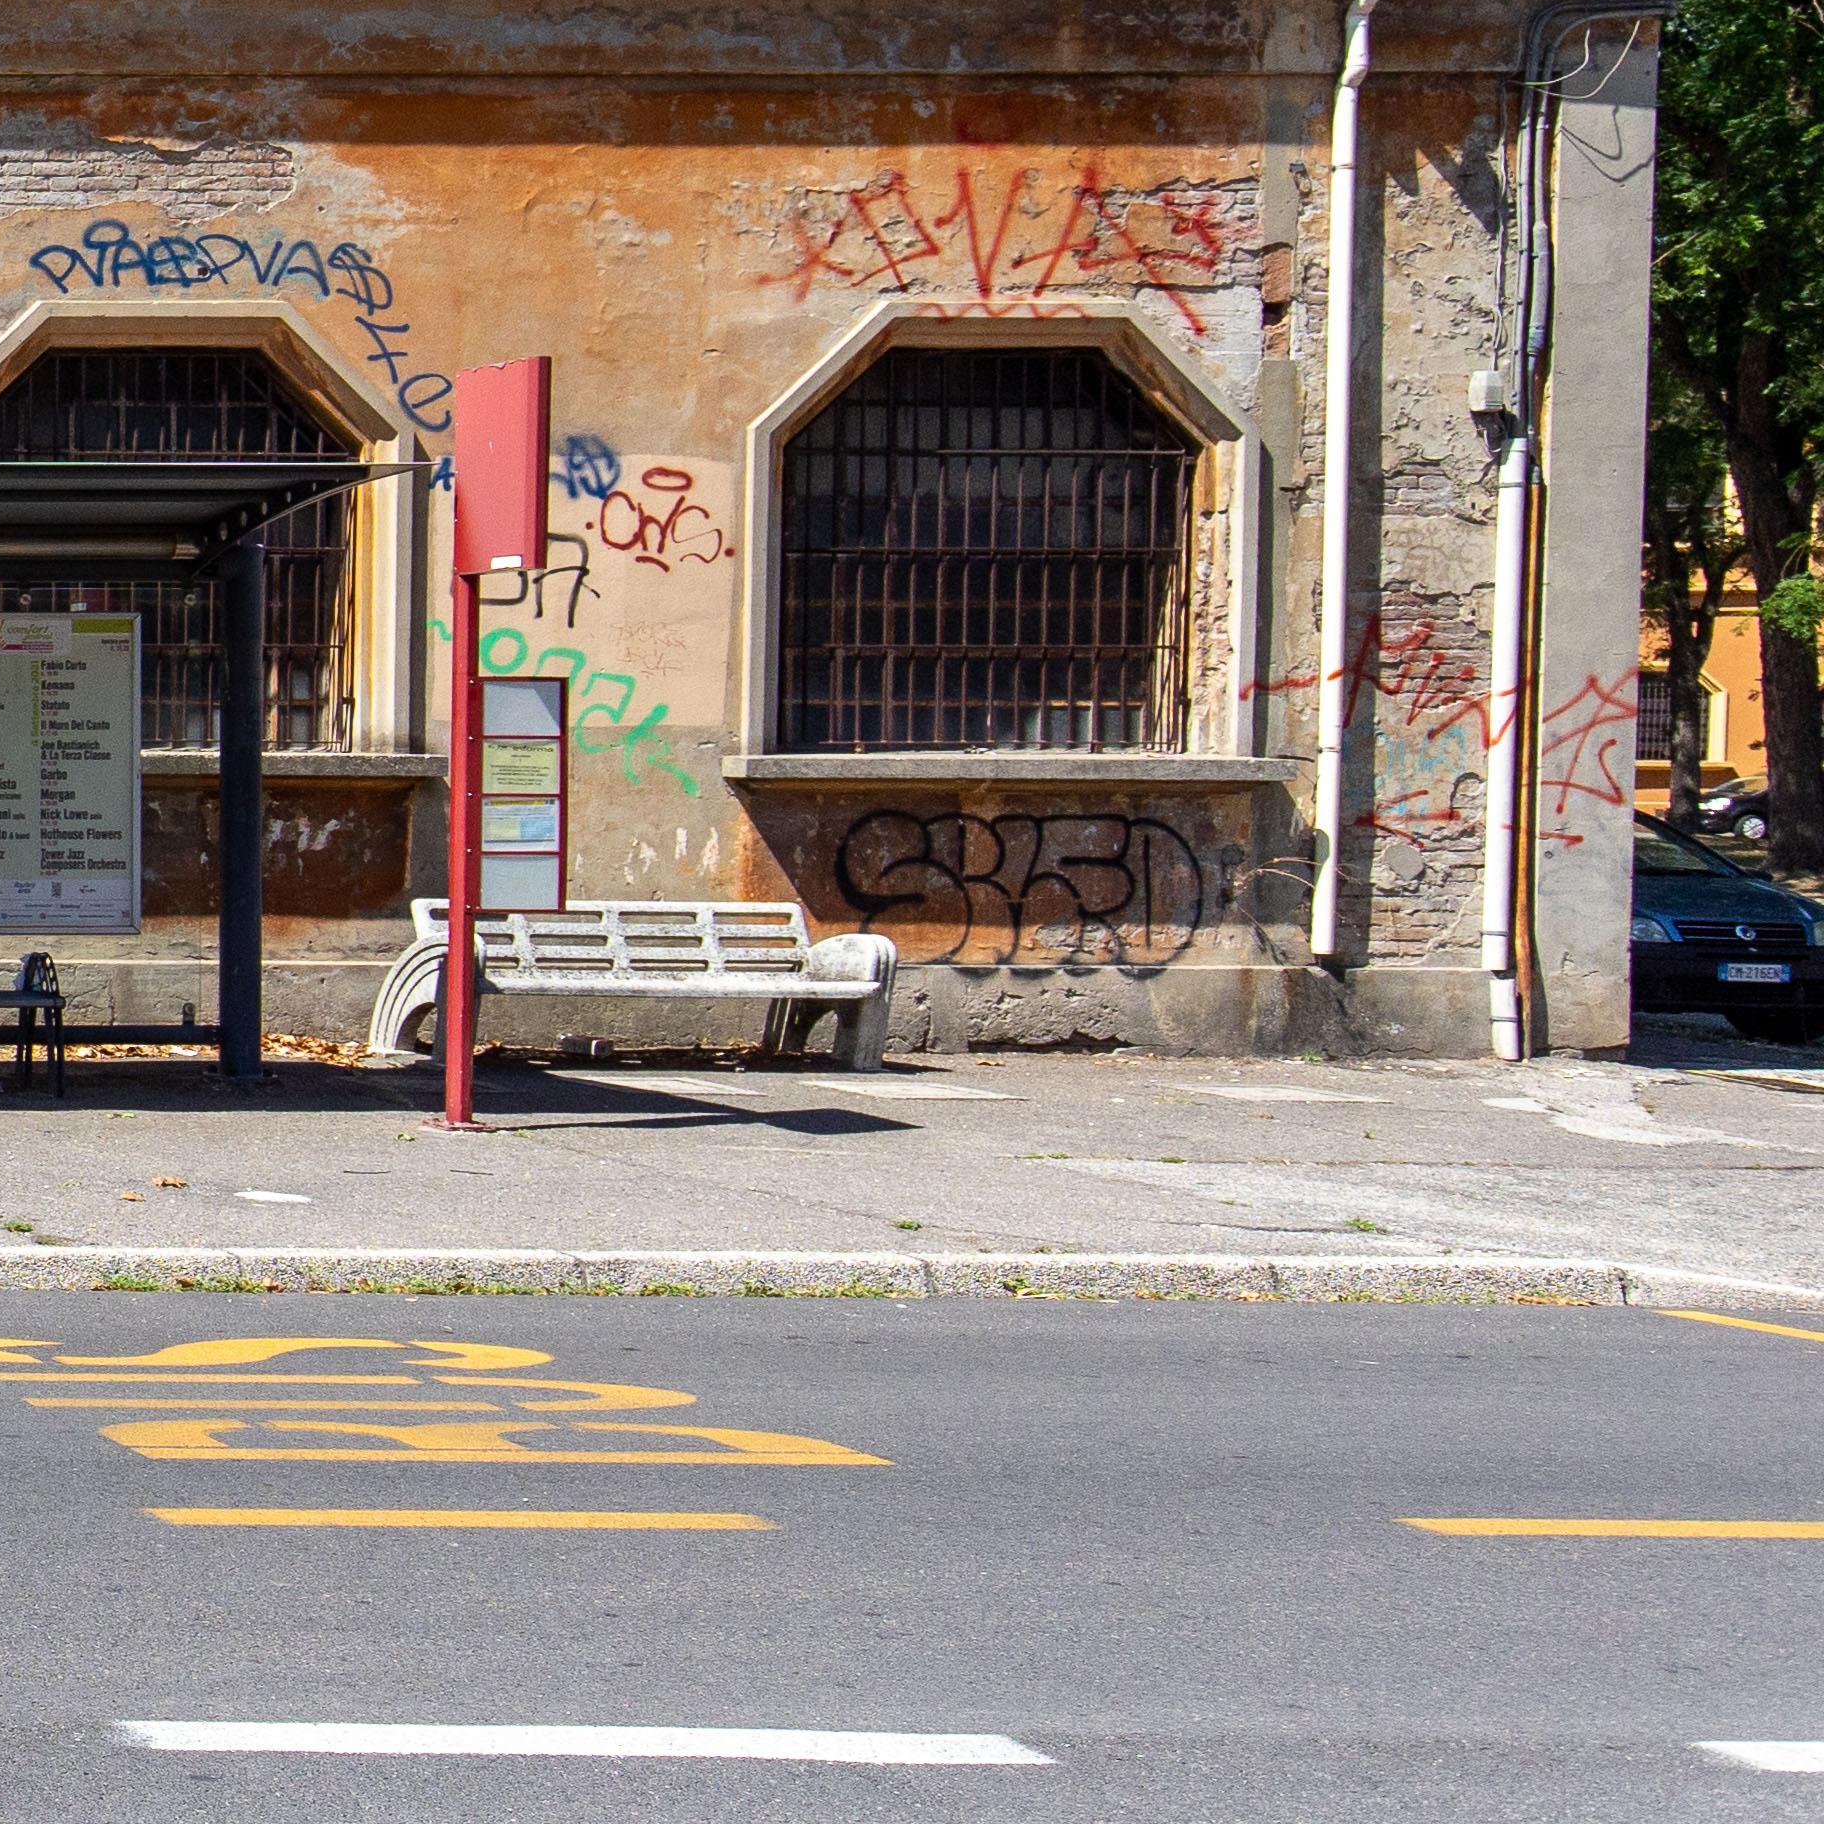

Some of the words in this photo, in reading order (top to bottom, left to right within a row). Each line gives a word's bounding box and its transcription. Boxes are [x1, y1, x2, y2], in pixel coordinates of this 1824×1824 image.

[41, 660, 63, 670] Fabio
[40, 769, 68, 780] Garbo
[40, 789, 76, 802] Morgan
[40, 808, 60, 820] Nick
[64, 808, 88, 820] Lowe
[40, 828, 84, 840] Hothouse
[86, 828, 122, 840] Flowers
[40, 848, 65, 859] Tower
[67, 848, 85, 859] Jazz
[40, 858, 86, 872] Composers
[88, 858, 127, 870] Orchestra
